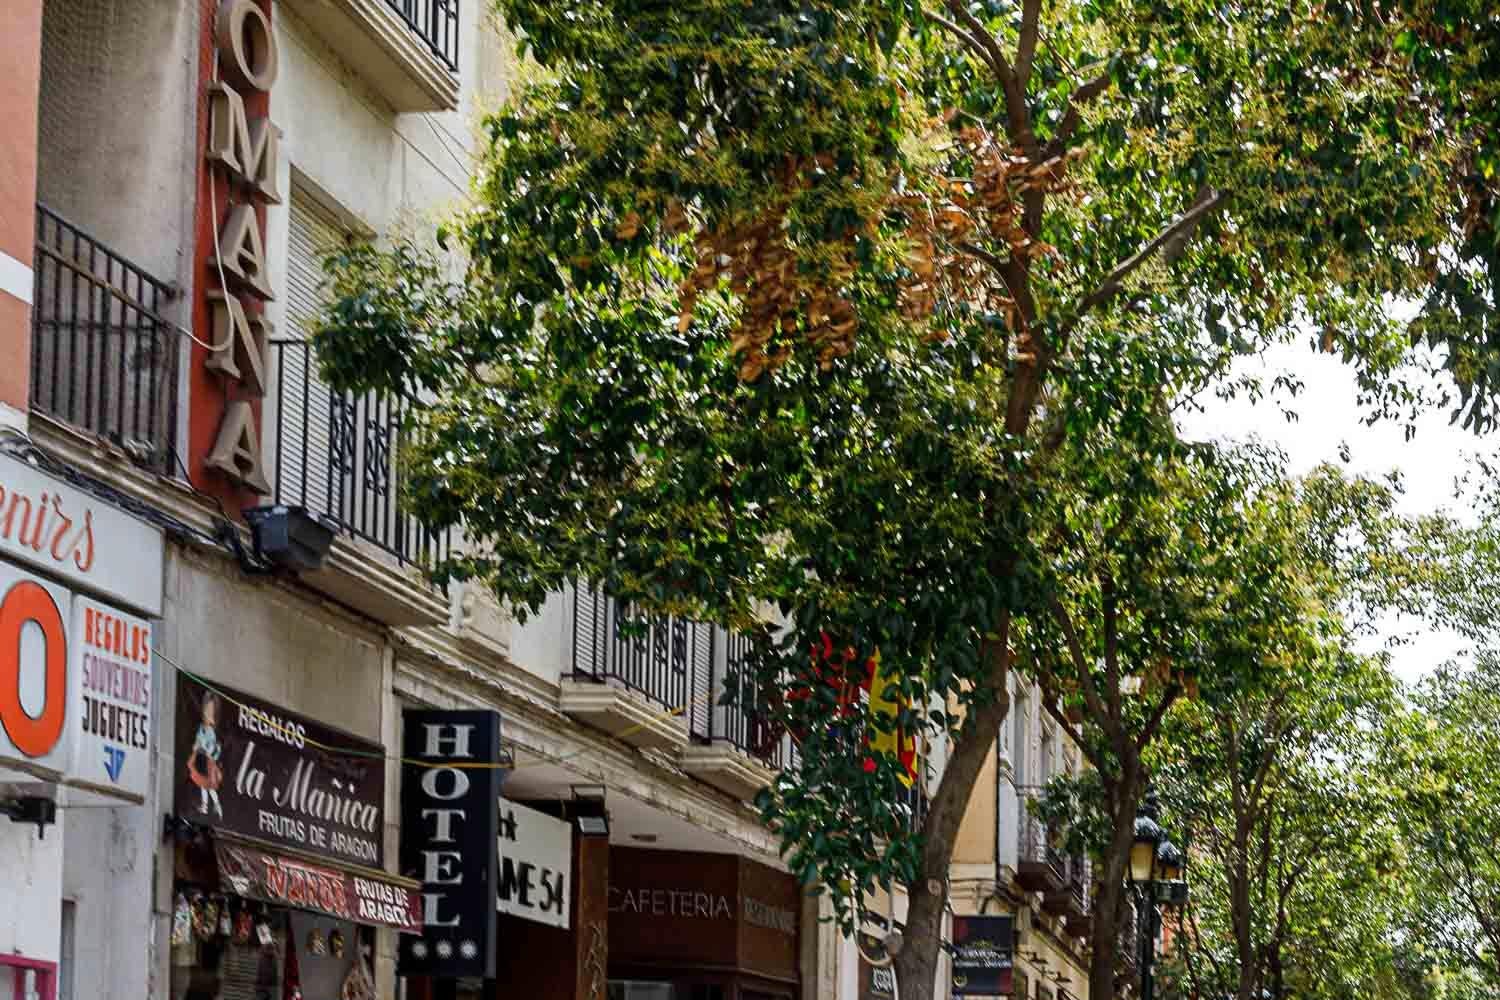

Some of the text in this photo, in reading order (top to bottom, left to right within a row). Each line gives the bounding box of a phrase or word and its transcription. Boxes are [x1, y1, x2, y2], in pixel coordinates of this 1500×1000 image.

[84, 607, 149, 665] REGALOS
[82, 652, 149, 709] SOUVENIRS
[82, 695, 148, 749] JUGUETES
[238, 703, 306, 749] REGALOS
[236, 741, 378, 833] la Mañica
[258, 809, 305, 842] FRUTAS
[309, 823, 327, 849] DE
[421, 724, 475, 926] HOTEL
[353, 876, 394, 904] FRUTAS
[539, 867, 564, 915] 54
[607, 884, 733, 920] CAFETERIA
